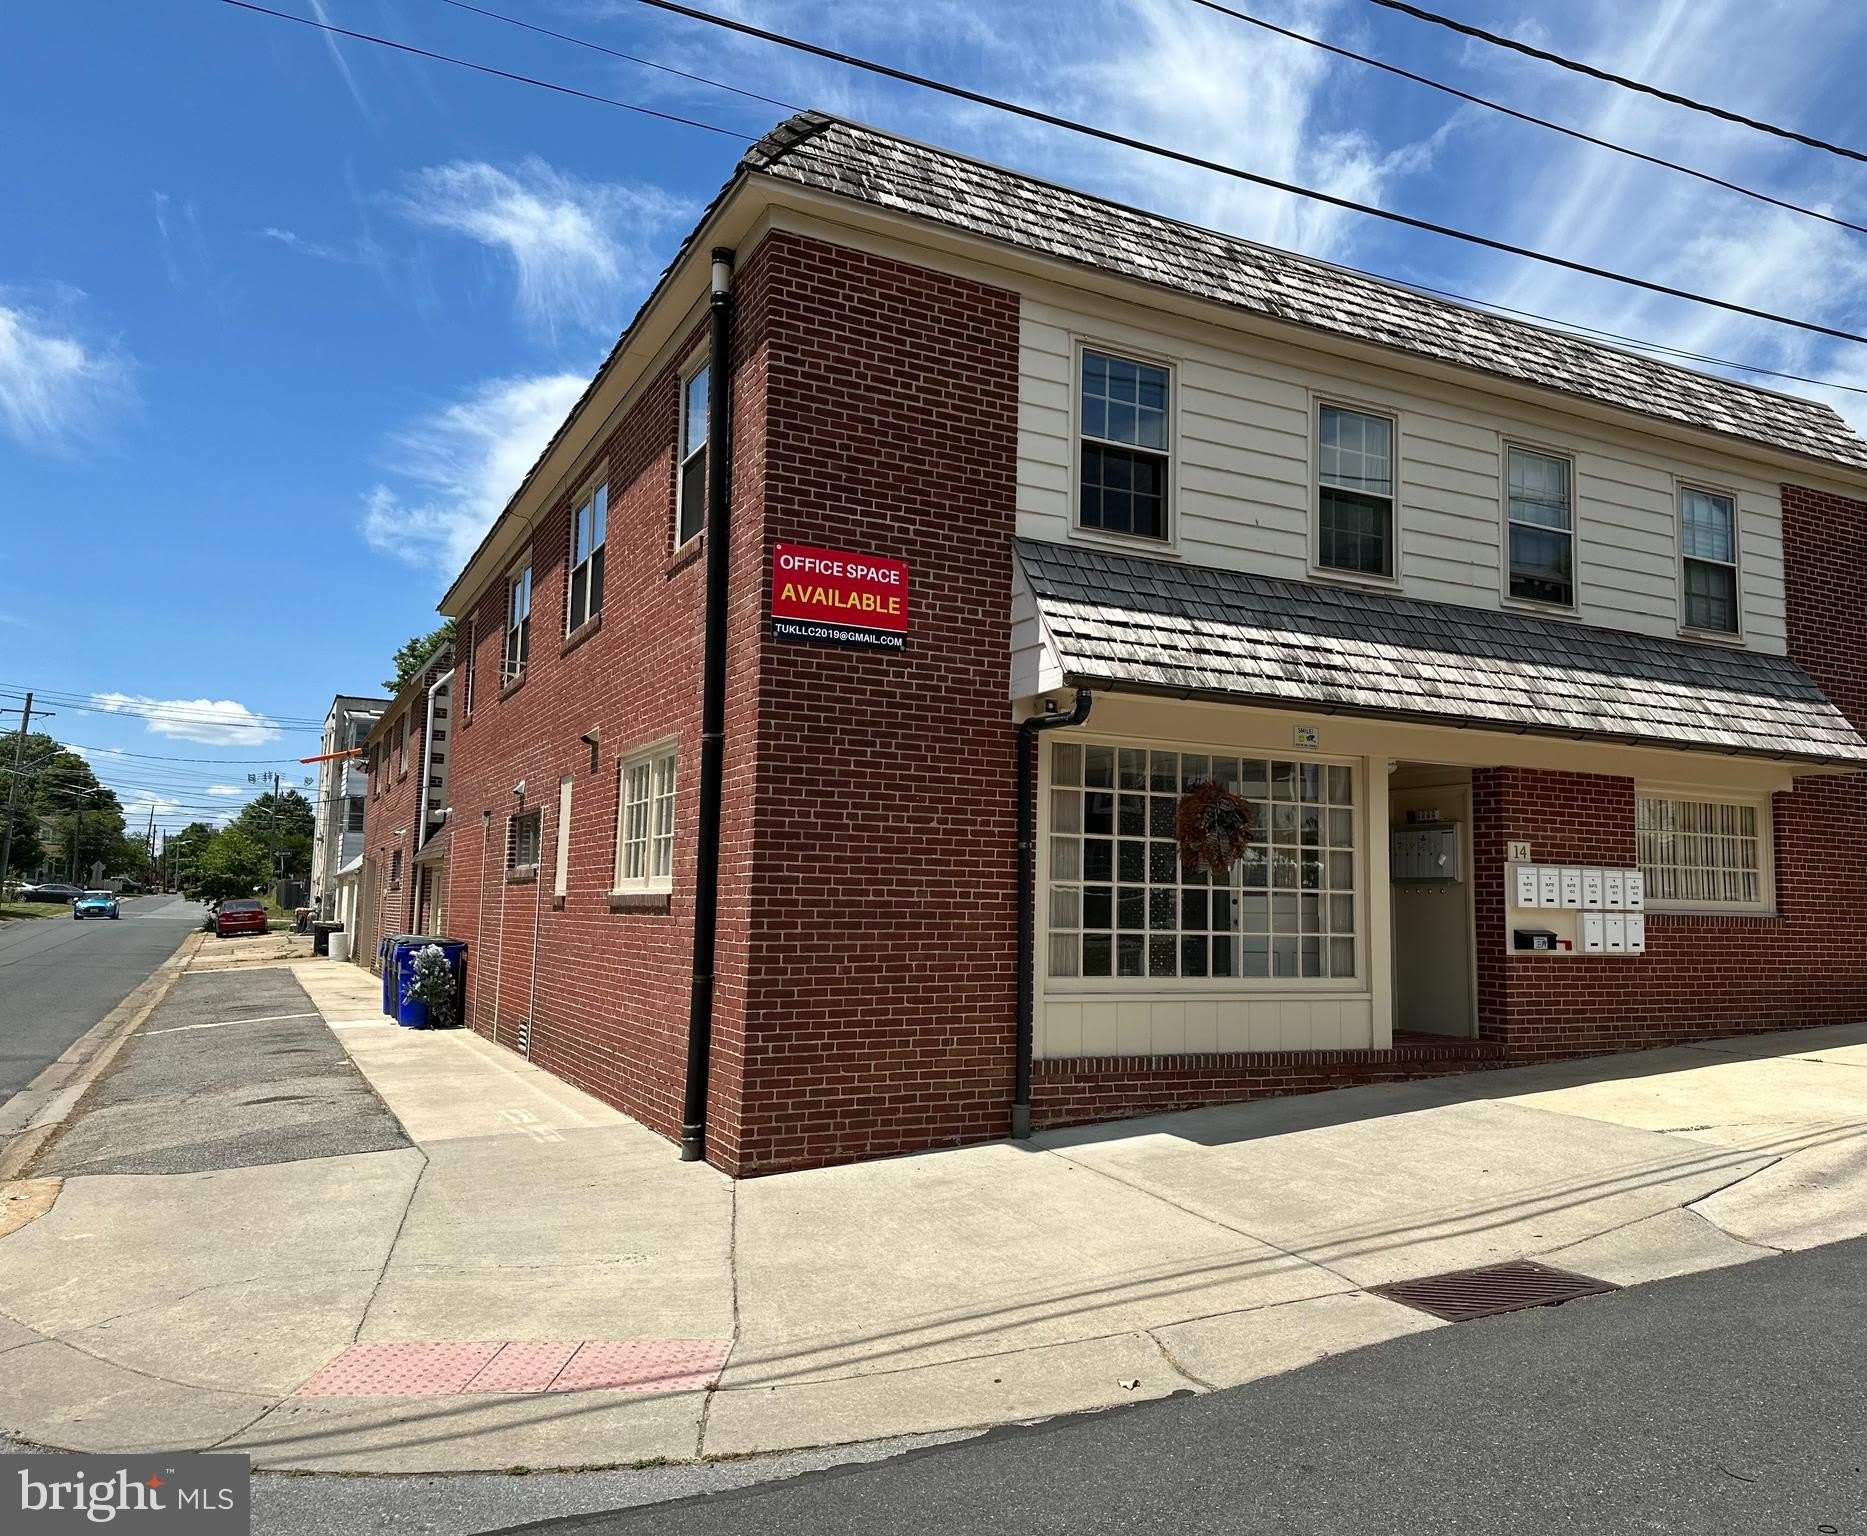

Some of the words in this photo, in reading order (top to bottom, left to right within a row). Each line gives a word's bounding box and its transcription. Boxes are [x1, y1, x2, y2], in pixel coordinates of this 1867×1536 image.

[780, 555, 843, 576] OFFICE
[846, 564, 900, 584] SPACE
[780, 583, 900, 614] AVAILABLE
[775, 623, 903, 646] TUKLLC2019@GMAIL.COM
[1513, 845, 1527, 859] 14
